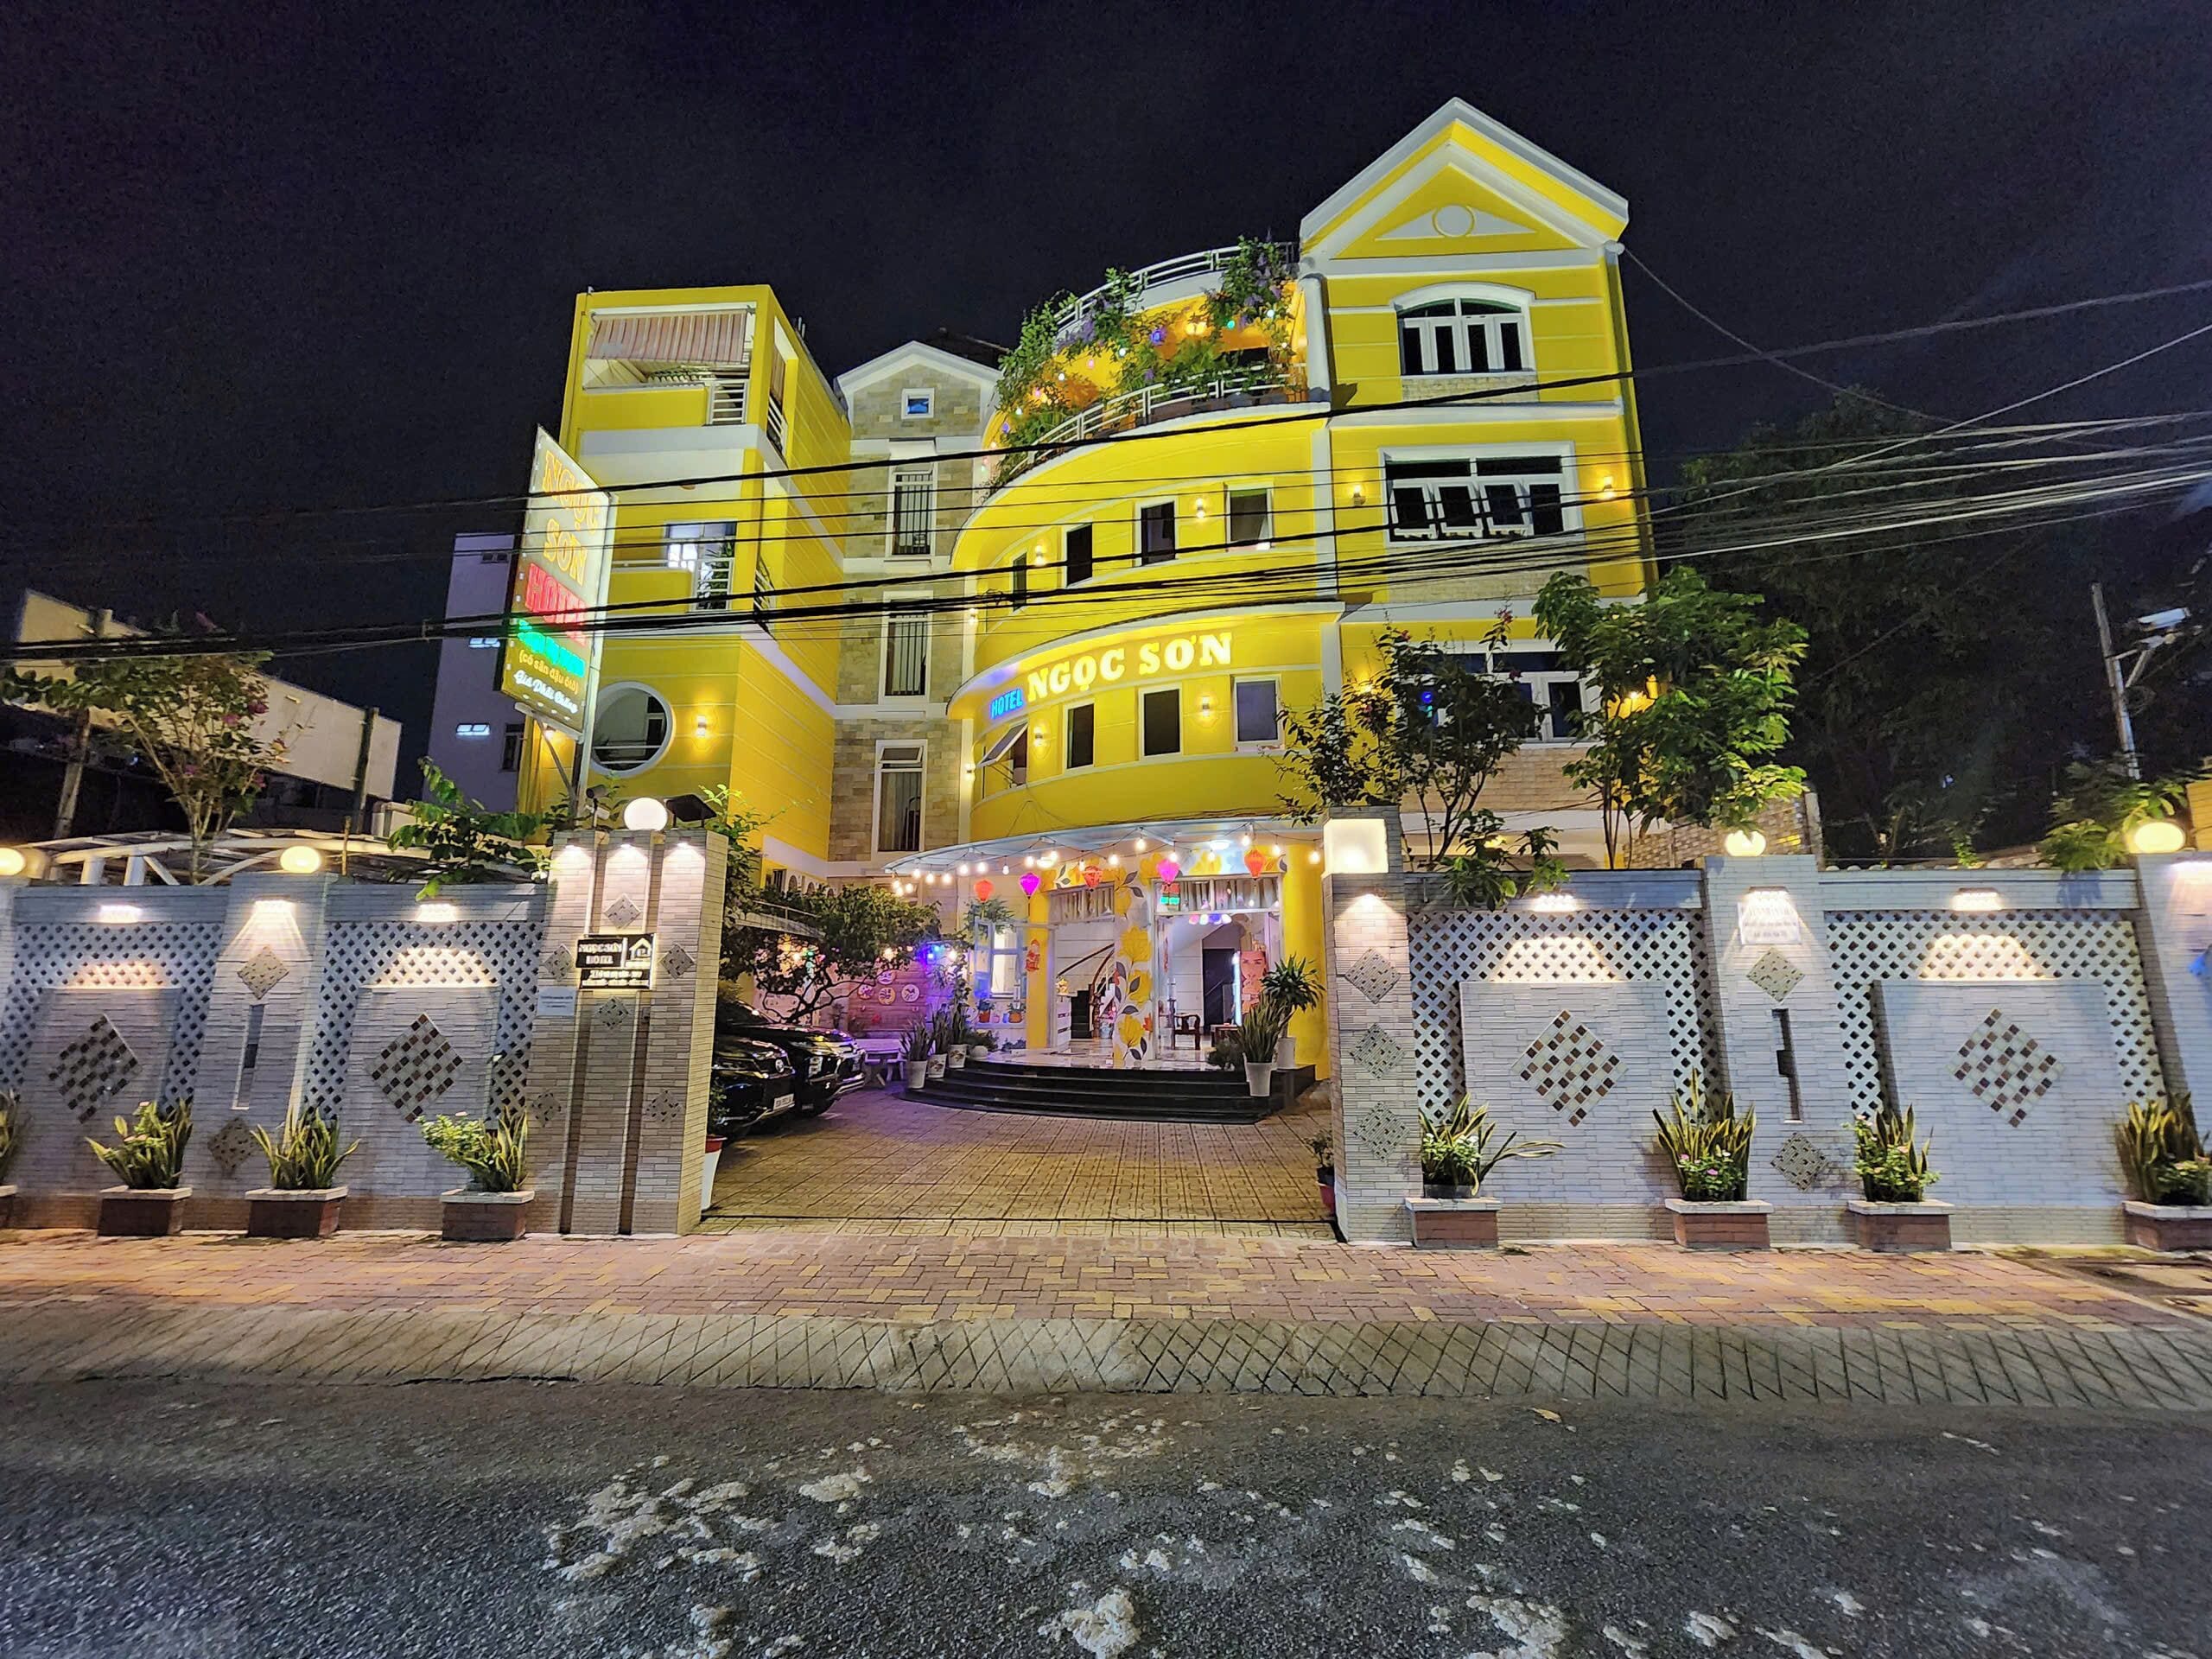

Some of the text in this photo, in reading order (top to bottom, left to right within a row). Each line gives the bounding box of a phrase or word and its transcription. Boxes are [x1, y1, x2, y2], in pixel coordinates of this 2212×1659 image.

[543, 448, 602, 536] NGỌC
[989, 632, 1233, 720] HOTEL NGỌC SƠN
